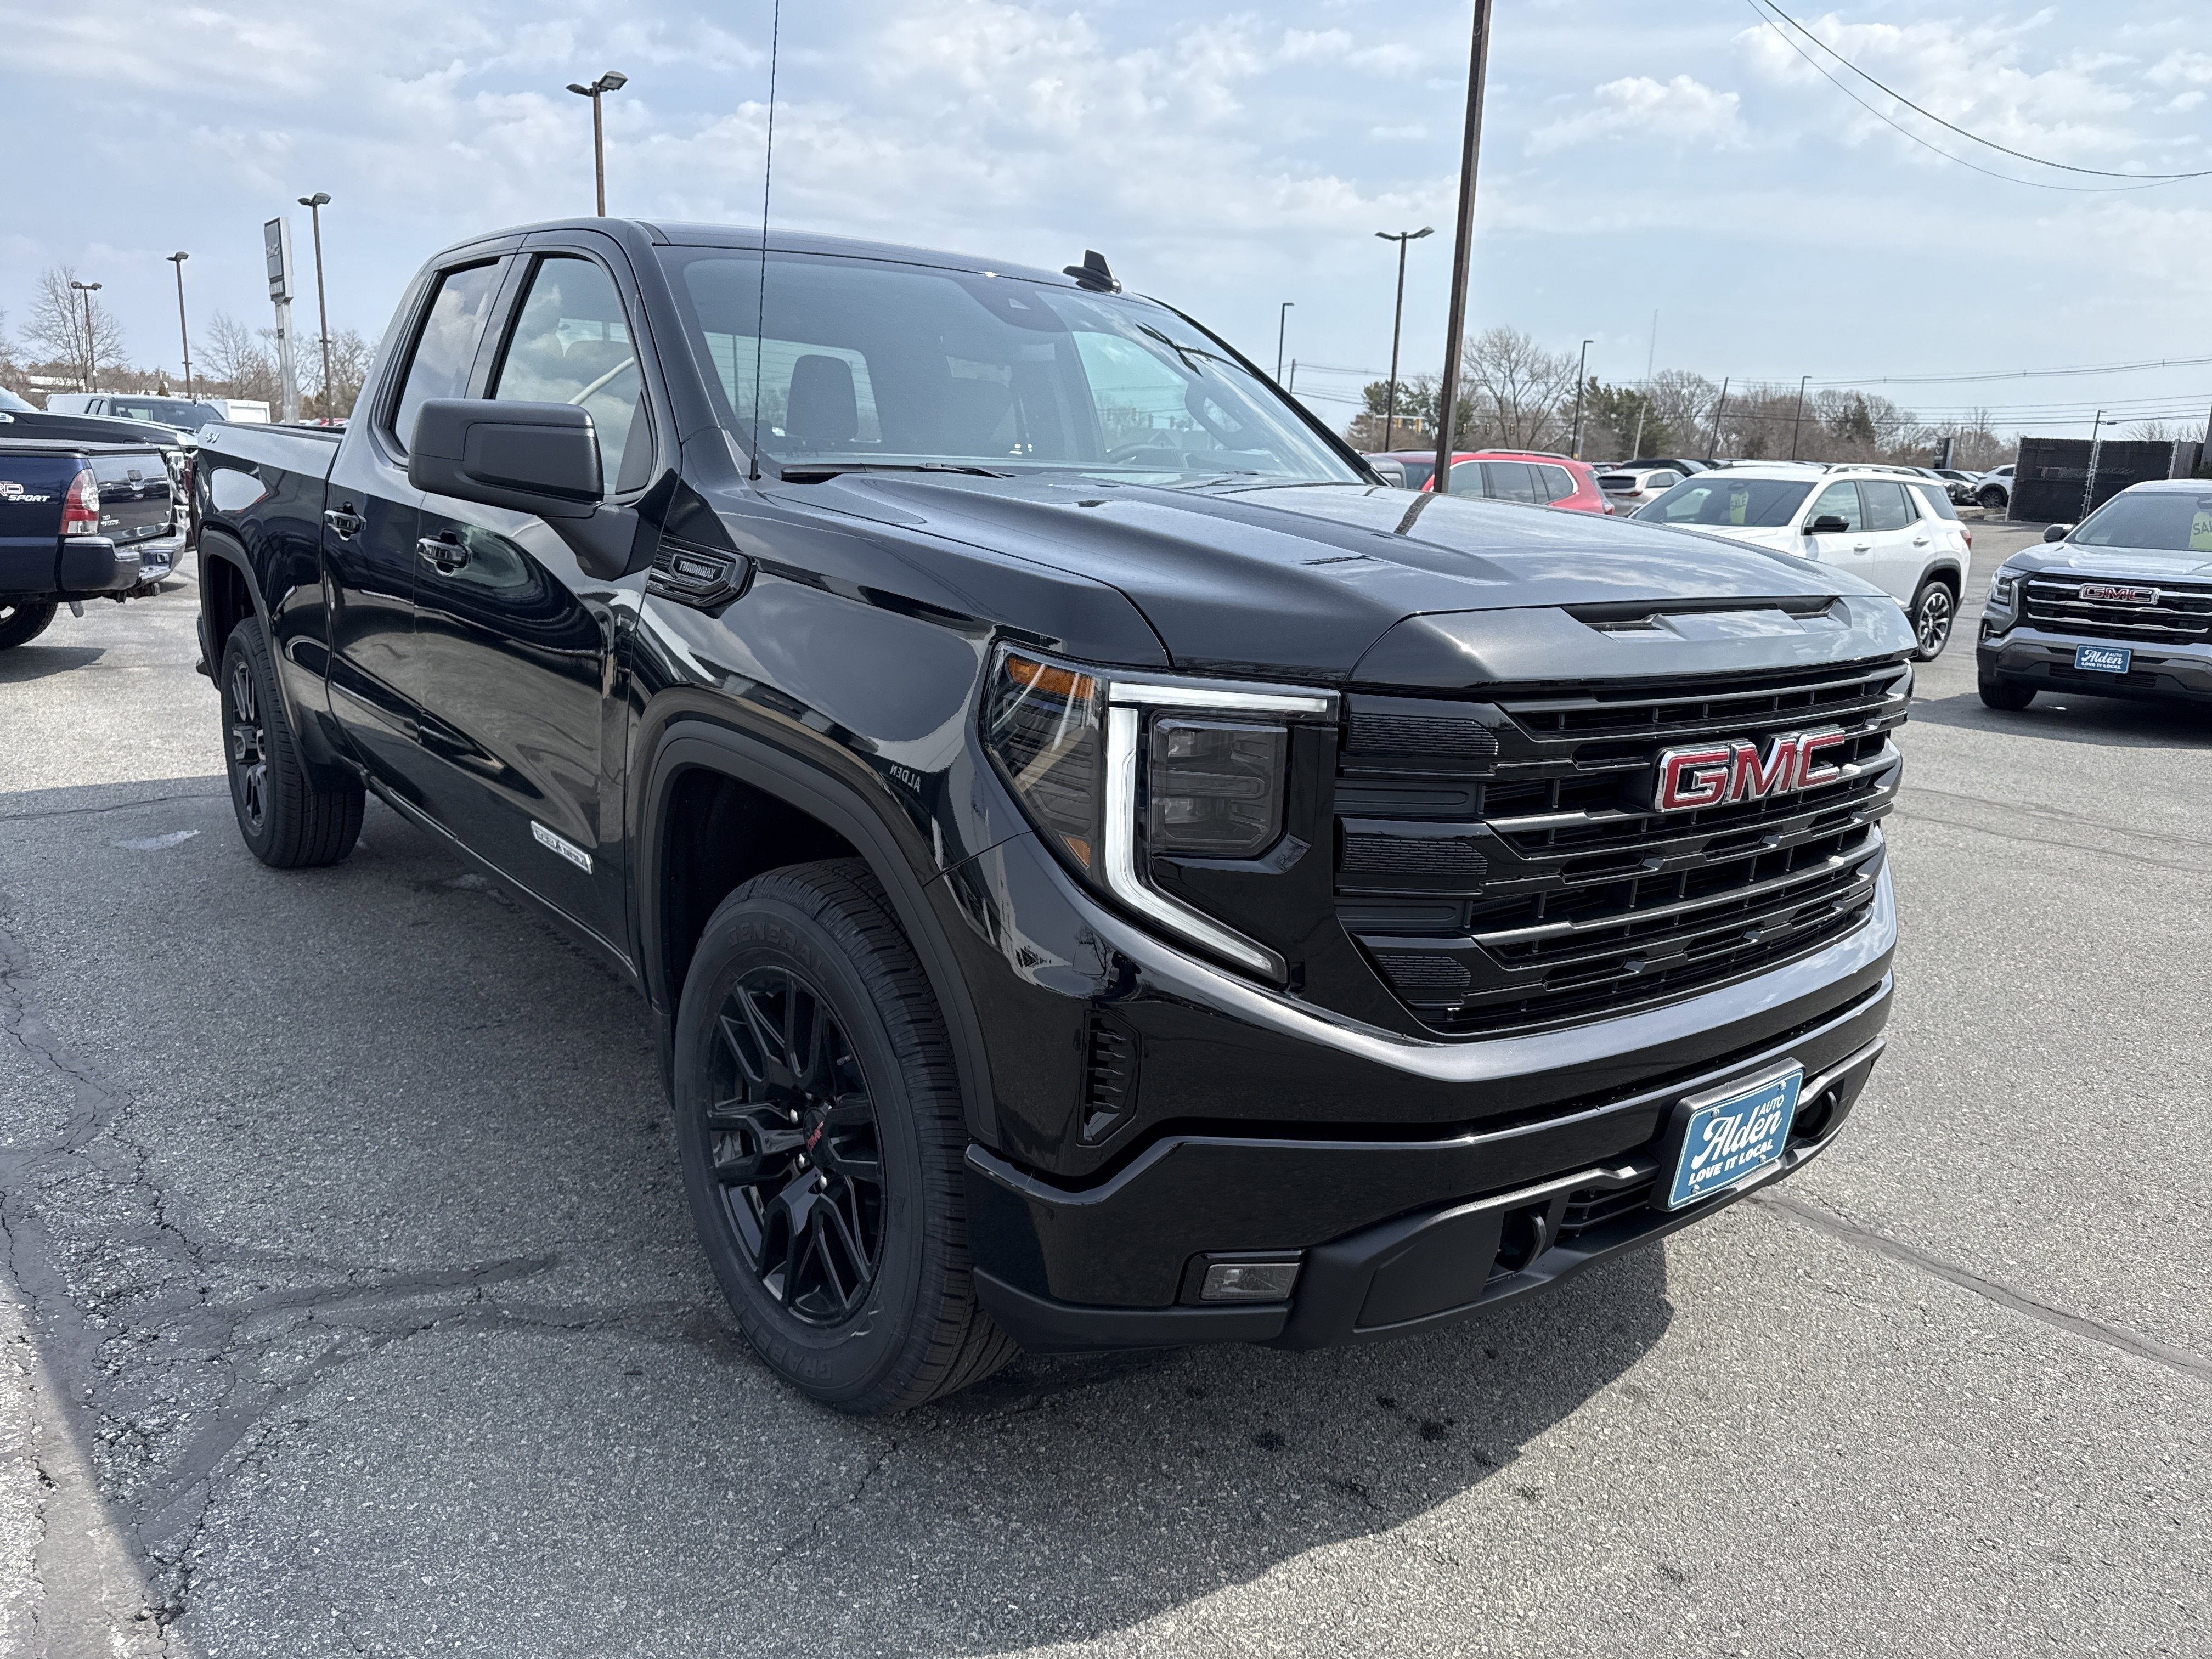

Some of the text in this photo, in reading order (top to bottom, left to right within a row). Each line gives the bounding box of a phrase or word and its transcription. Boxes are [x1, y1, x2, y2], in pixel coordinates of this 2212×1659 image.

[1731, 495, 1747, 511] SALE
[679, 560, 716, 579] TURBOMAX
[2084, 585, 2152, 602] GMC
[2081, 649, 2124, 664] Alden
[1655, 727, 1846, 812] GMC
[727, 921, 827, 983] GENERAL
[1758, 1094, 1785, 1117] AUTO
[1691, 1105, 1783, 1170] Alden
[1688, 1138, 1774, 1186] LOVE IT LOCAL
